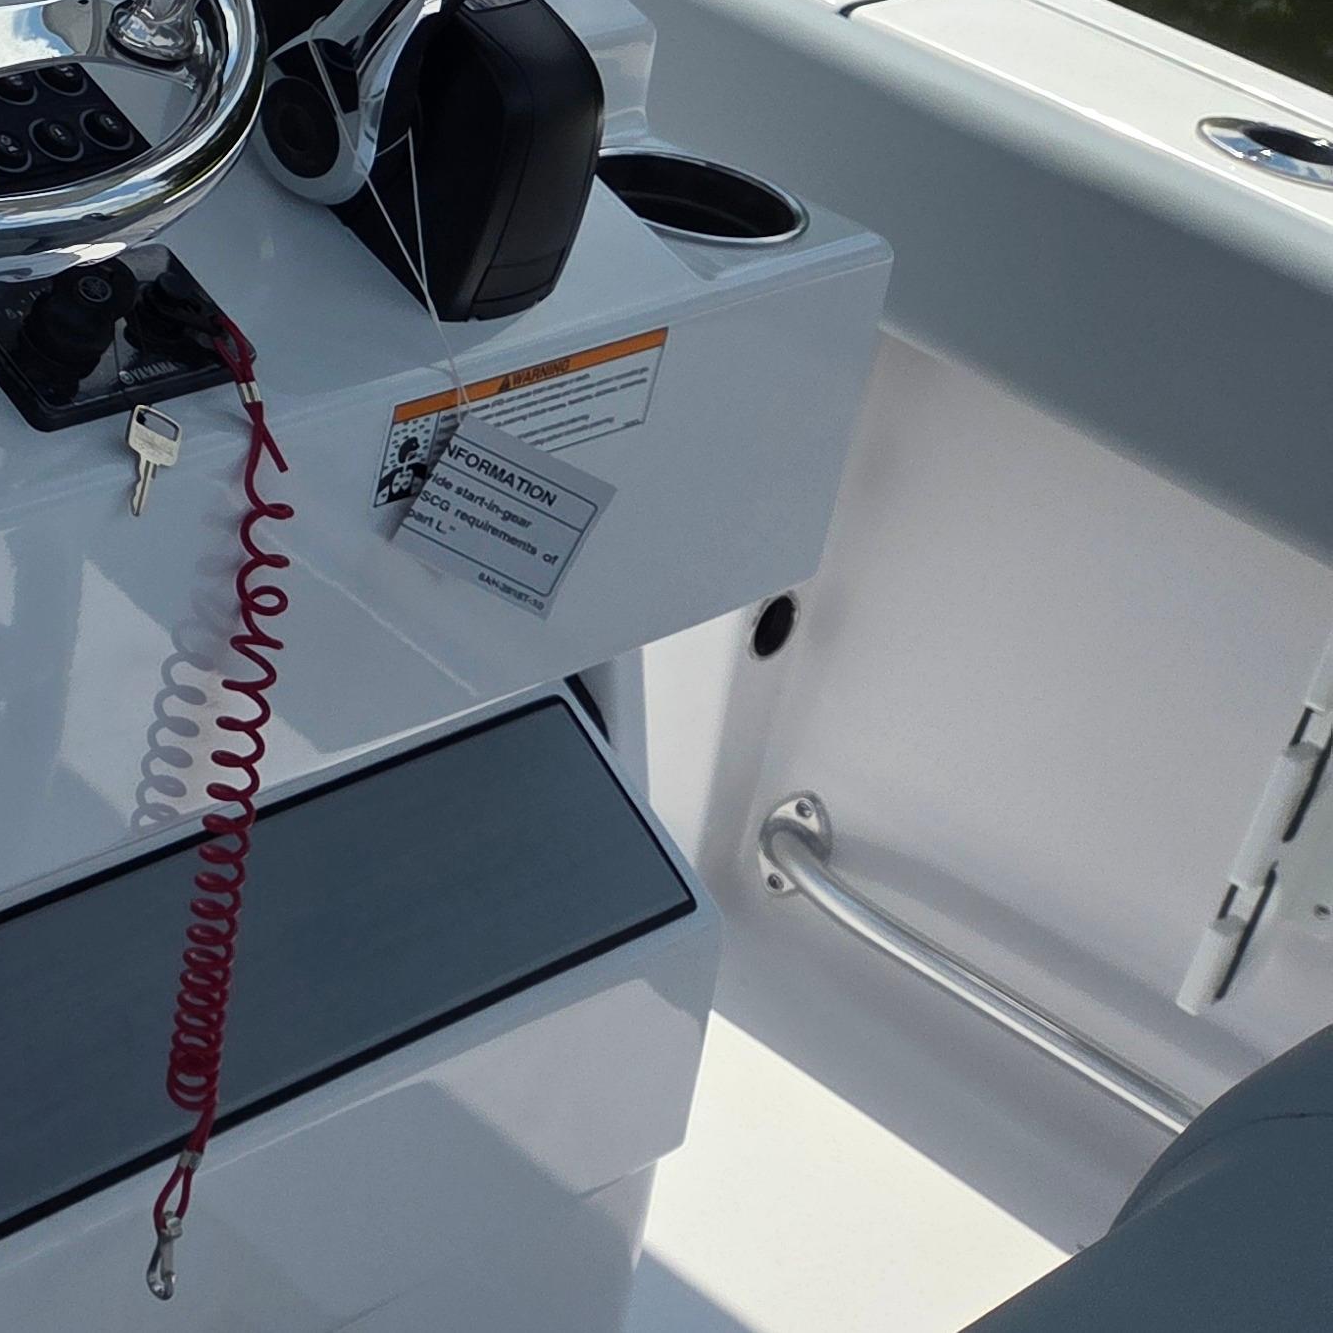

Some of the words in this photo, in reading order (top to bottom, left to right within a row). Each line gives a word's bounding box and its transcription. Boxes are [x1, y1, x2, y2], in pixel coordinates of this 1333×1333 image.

[131, 361, 179, 382] YAMAHA
[511, 359, 571, 387] WARNING
[444, 442, 558, 508] NFORMATION
[420, 490, 451, 512] SCG
[454, 507, 538, 556] requirements
[542, 551, 560, 566] of
[454, 483, 533, 529] start-in-gear
